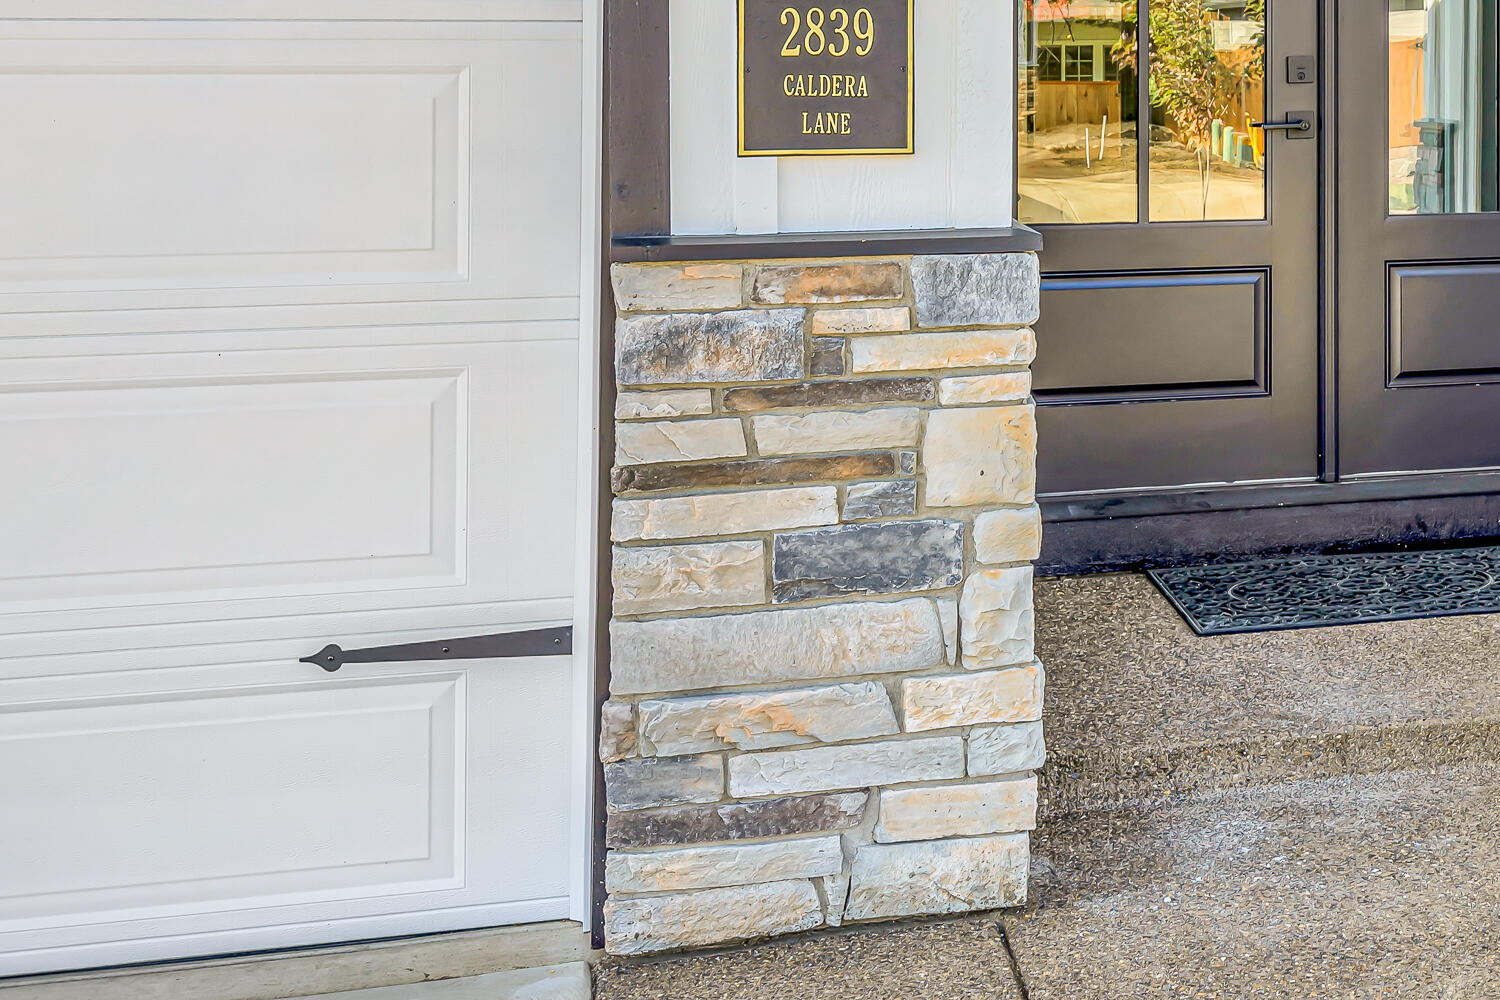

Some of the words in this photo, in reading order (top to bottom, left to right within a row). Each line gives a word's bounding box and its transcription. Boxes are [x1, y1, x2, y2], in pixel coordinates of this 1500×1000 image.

[780, 7, 874, 56] 2839
[783, 74, 868, 97] CALDERA
[802, 112, 851, 134] LANE
